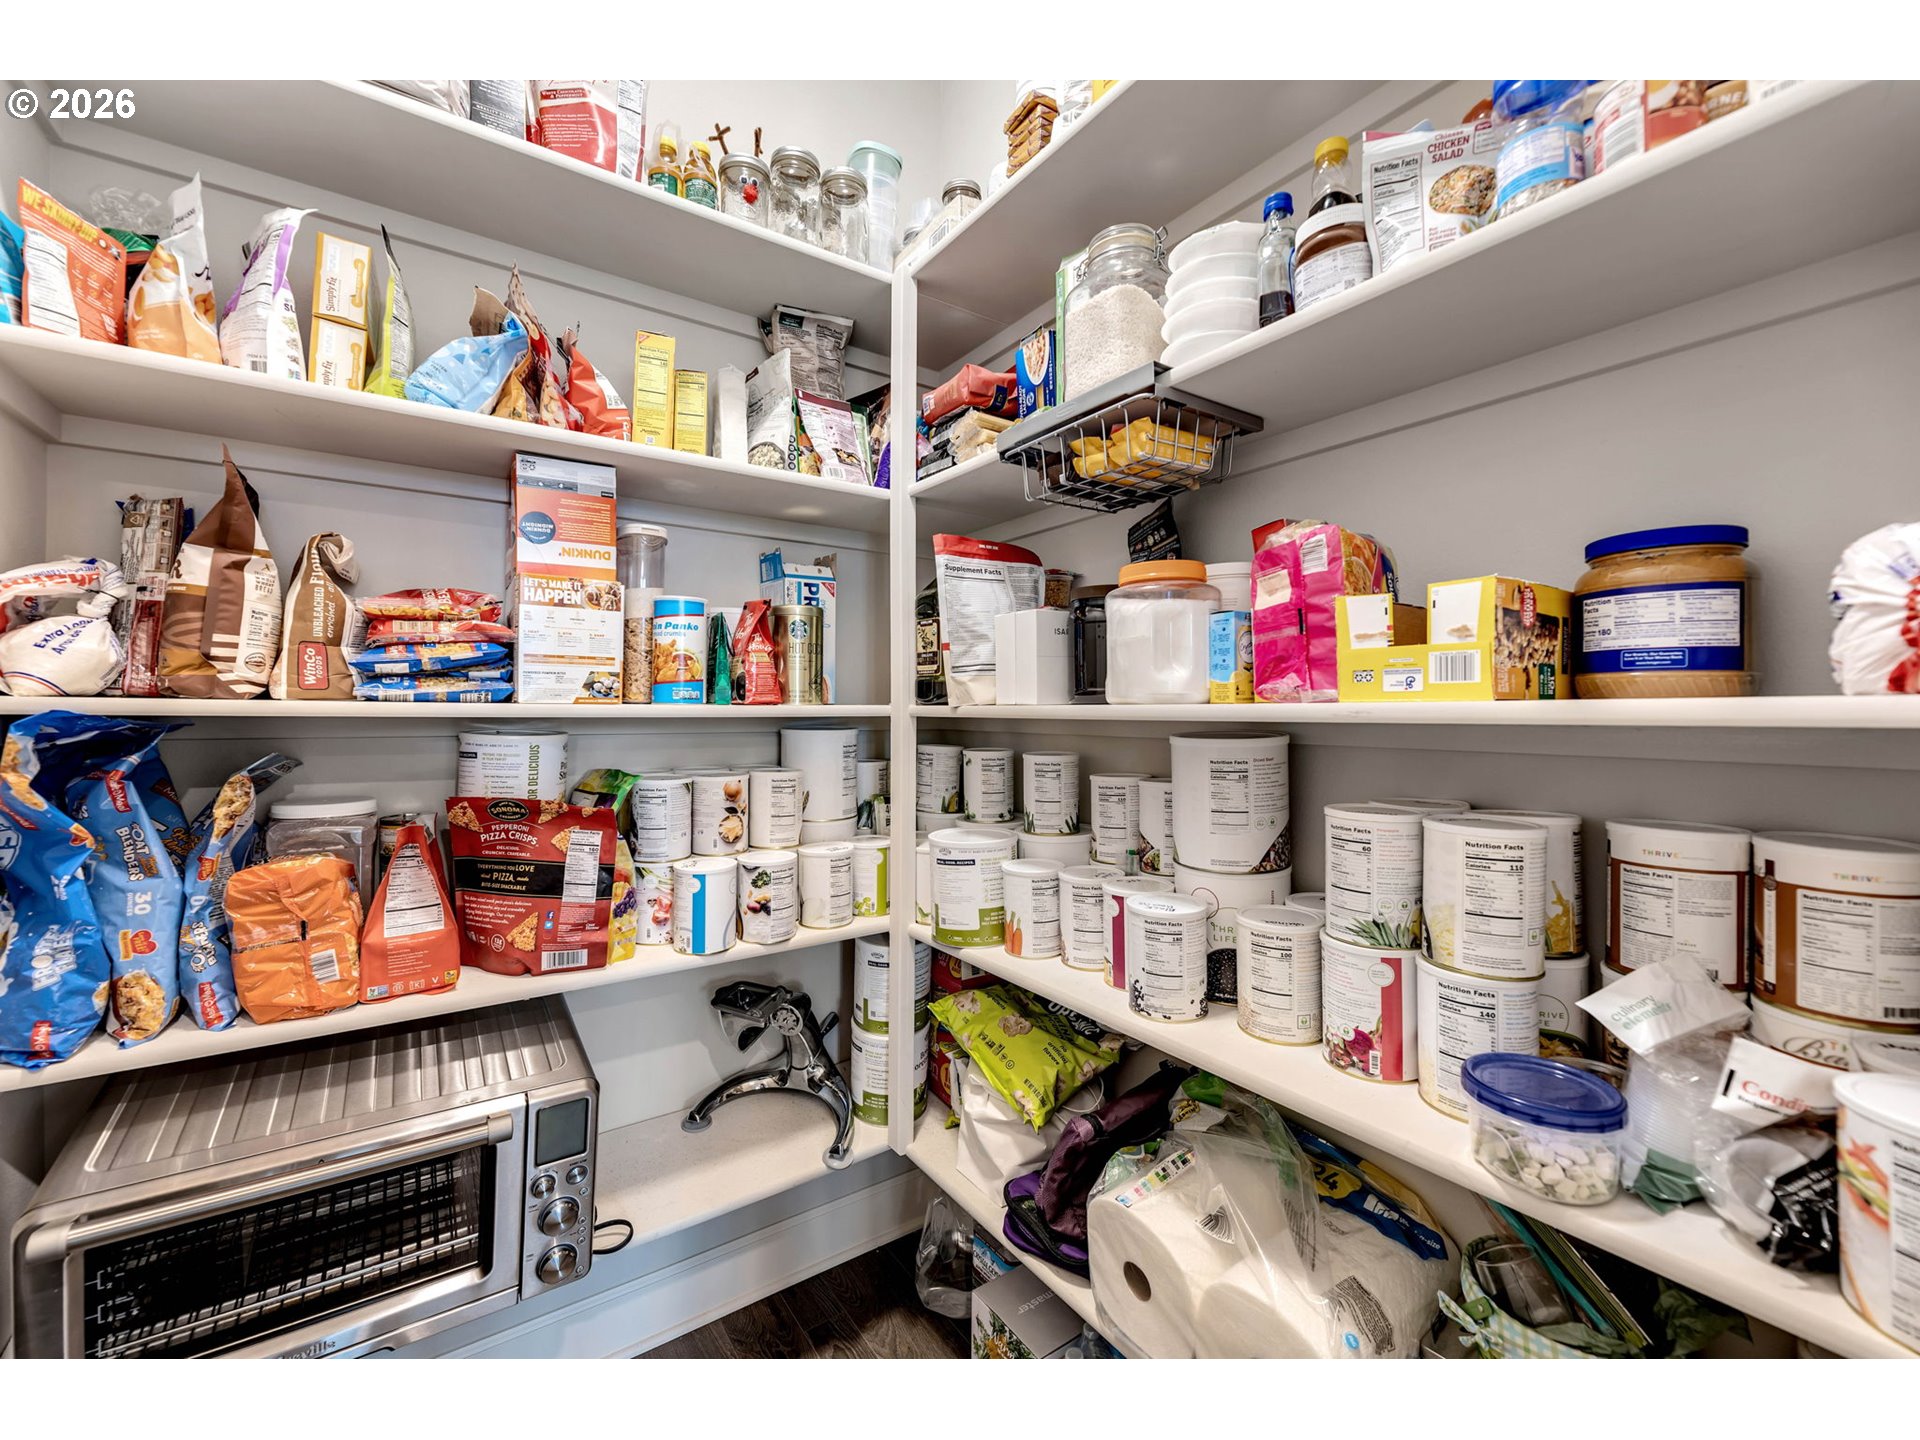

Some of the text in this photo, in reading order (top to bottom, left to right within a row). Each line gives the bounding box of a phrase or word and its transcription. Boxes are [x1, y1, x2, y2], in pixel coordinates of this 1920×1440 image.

[1428, 135, 1470, 154] CHICKEN
[1432, 148, 1464, 164] SALAD
[1374, 158, 1418, 174] Nutrition Facts
[326, 286, 338, 312] Simply
[945, 563, 1002, 576] Supplement Facts
[524, 576, 582, 591] LET'S MAKE IT
[524, 587, 581, 604] HAPPEN
[1584, 598, 1612, 606] Nutrition
[312, 586, 324, 638] UNBLEACHED
[326, 601, 336, 638] enriched
[664, 620, 699, 631] Panko
[1598, 628, 1612, 636] 180
[34, 629, 64, 650] Extra
[663, 630, 686, 638] crumbs
[789, 642, 804, 652] HOT
[304, 648, 316, 686] WinCo
[528, 744, 540, 787] DELICIOUS
[490, 806, 526, 814] SONOMA
[491, 824, 530, 832] PEPPERONI
[131, 823, 150, 854] OAT
[480, 832, 506, 842] PIZZA
[1465, 842, 1502, 850] Nutrition
[1642, 848, 1680, 859] THRIVE
[117, 827, 145, 881] BLENDERS
[516, 864, 536, 872] LOVE
[1465, 862, 1524, 872] Calories 110
[1623, 866, 1673, 880] Nutrition Facts
[1833, 872, 1883, 884] THRIVE
[126, 892, 134, 916] OUNCES
[134, 891, 152, 915] 30
[1803, 893, 1874, 908] Nutrition Facts
[1213, 921, 1236, 934] THR
[1250, 932, 1274, 941] Nutrition
[1438, 981, 1496, 999] Nutrition Facts
[1438, 1002, 1496, 1018] Calories 140
[1610, 993, 1658, 1022] culinary
[1538, 1011, 1565, 1020] RIVE
[1042, 1047, 1060, 1066] flavors
[1047, 1042, 1069, 1065] artificial
[1018, 1290, 1054, 1314] master
